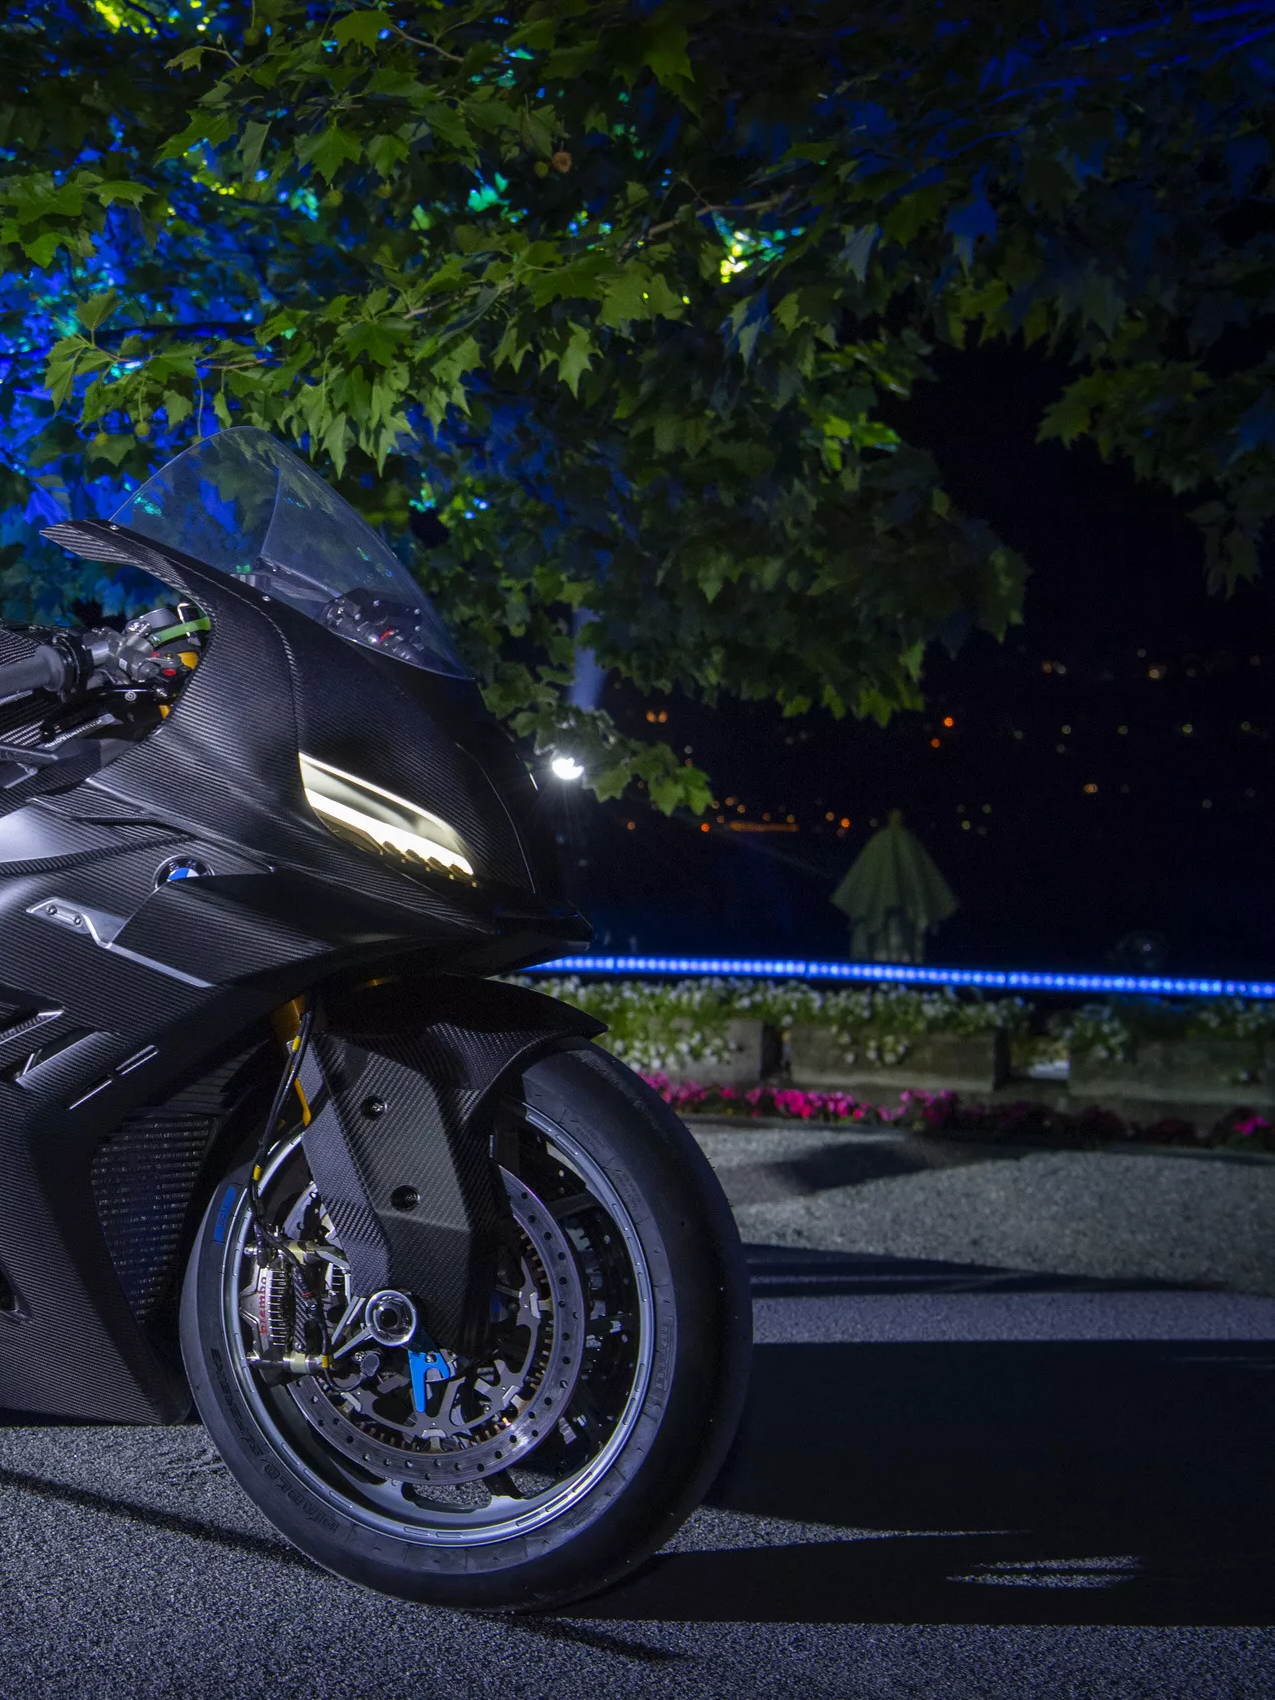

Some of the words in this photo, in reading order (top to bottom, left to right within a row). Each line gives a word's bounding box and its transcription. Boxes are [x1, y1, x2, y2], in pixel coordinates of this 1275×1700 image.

[257, 1277, 268, 1335] brembo
[211, 1349, 264, 1456] SUPERBIKE
[262, 1460, 339, 1532] DIABLO
